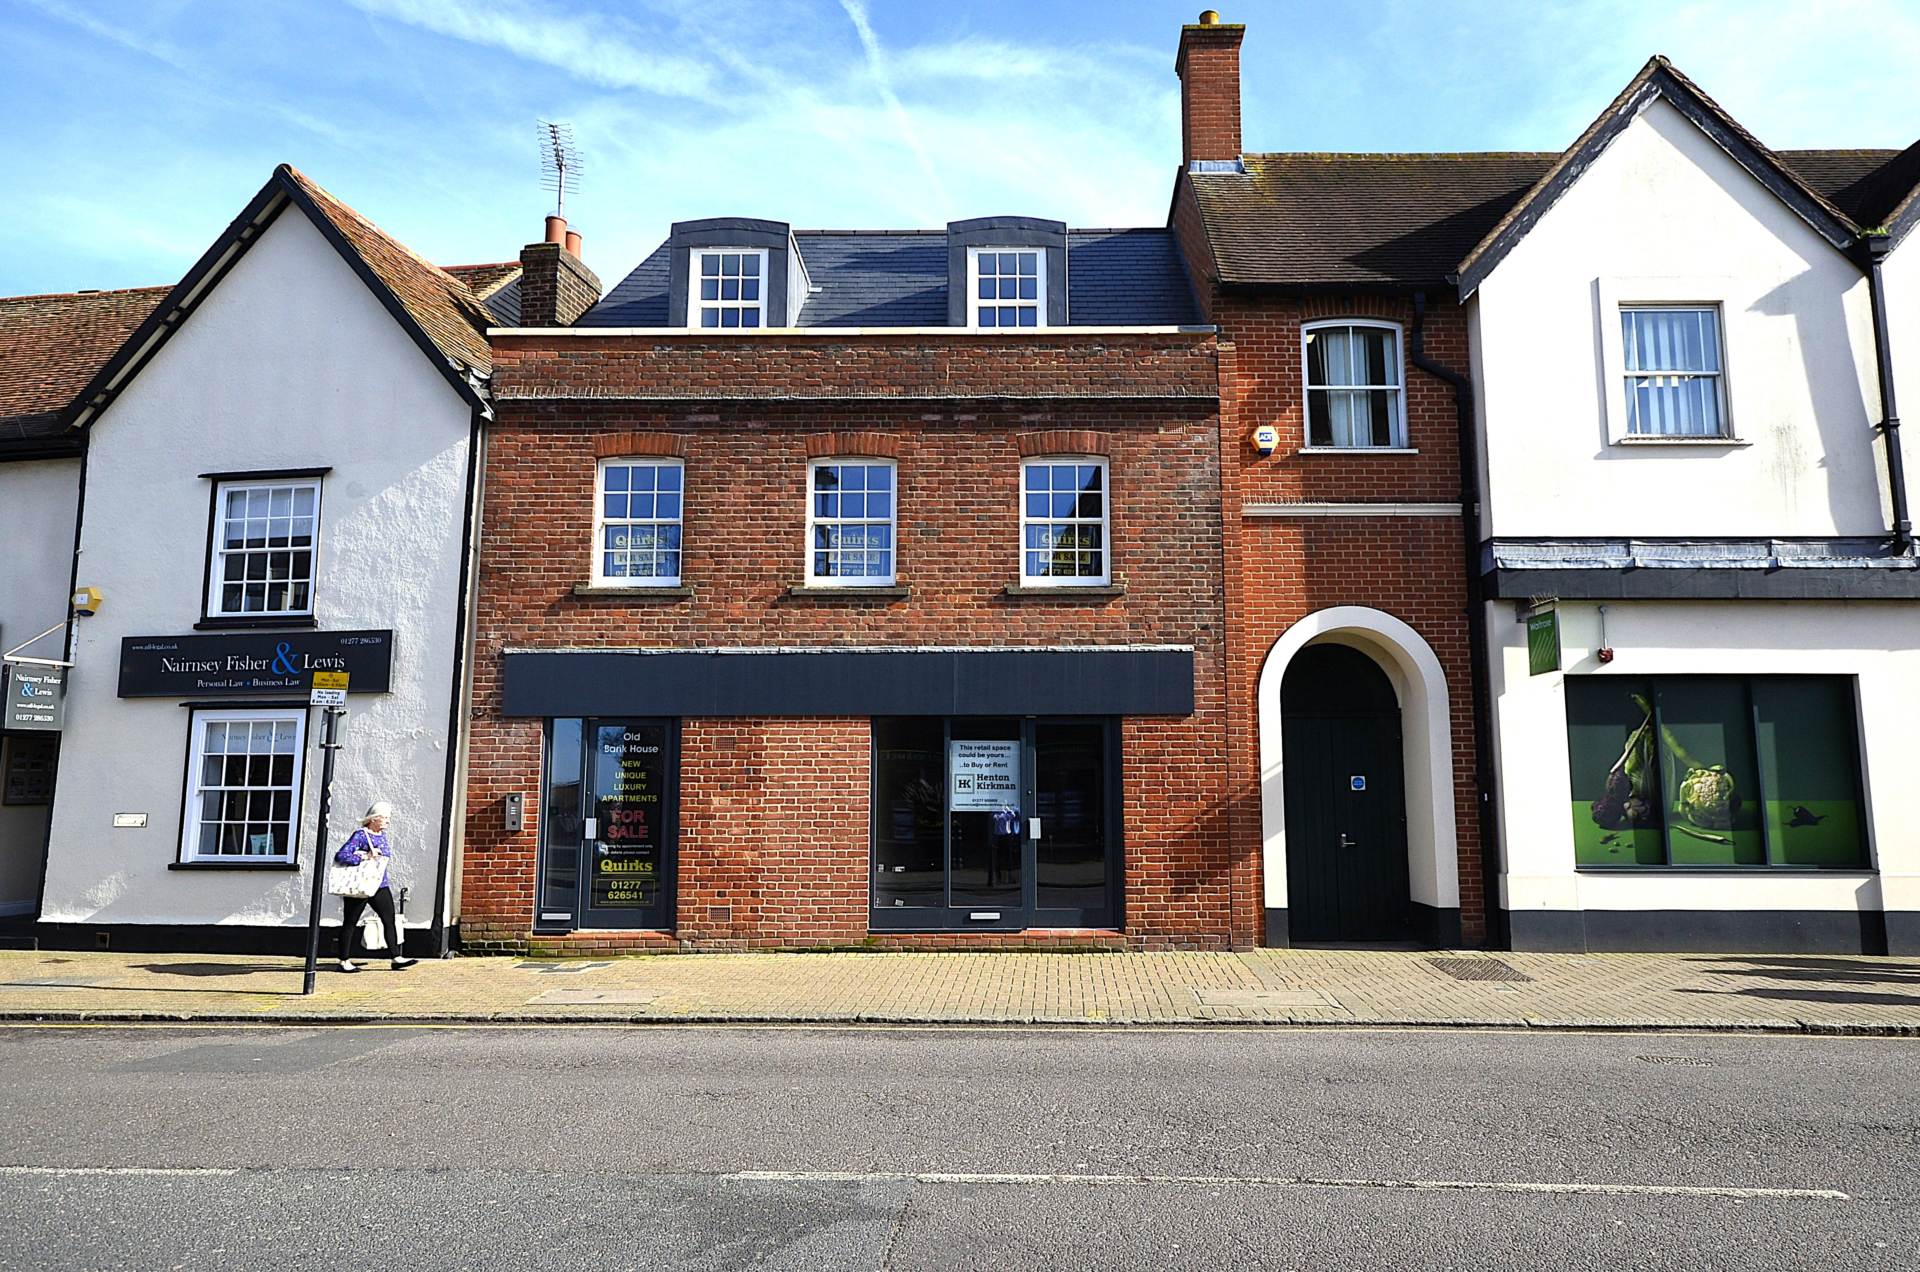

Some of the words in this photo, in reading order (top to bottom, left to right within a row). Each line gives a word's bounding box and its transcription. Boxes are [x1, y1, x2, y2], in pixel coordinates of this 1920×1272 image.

[1063, 552, 1086, 561] SAE
[161, 657, 221, 675] Nairnsey
[226, 655, 269, 671] Fisher
[271, 641, 301, 675] &
[304, 652, 345, 669] Lewis
[43, 675, 62, 685] Fisher
[197, 679, 227, 688] Personal
[229, 679, 243, 687] Law
[252, 678, 283, 687] Business
[285, 677, 300, 686] Law
[21, 682, 35, 697] &
[35, 687, 53, 696] Lewis
[623, 732, 641, 741] Old
[604, 744, 627, 753] Bank
[629, 744, 659, 753] House
[621, 760, 641, 768] NEW
[615, 771, 648, 779] UNIQUE
[613, 783, 647, 791] LUXURY
[601, 794, 658, 802] APARTMENTS
[611, 810, 645, 823] FOR
[607, 825, 649, 838] SALE
[600, 859, 653, 872] Quirks
[611, 881, 641, 889] 01277
[607, 891, 643, 900] 626541
